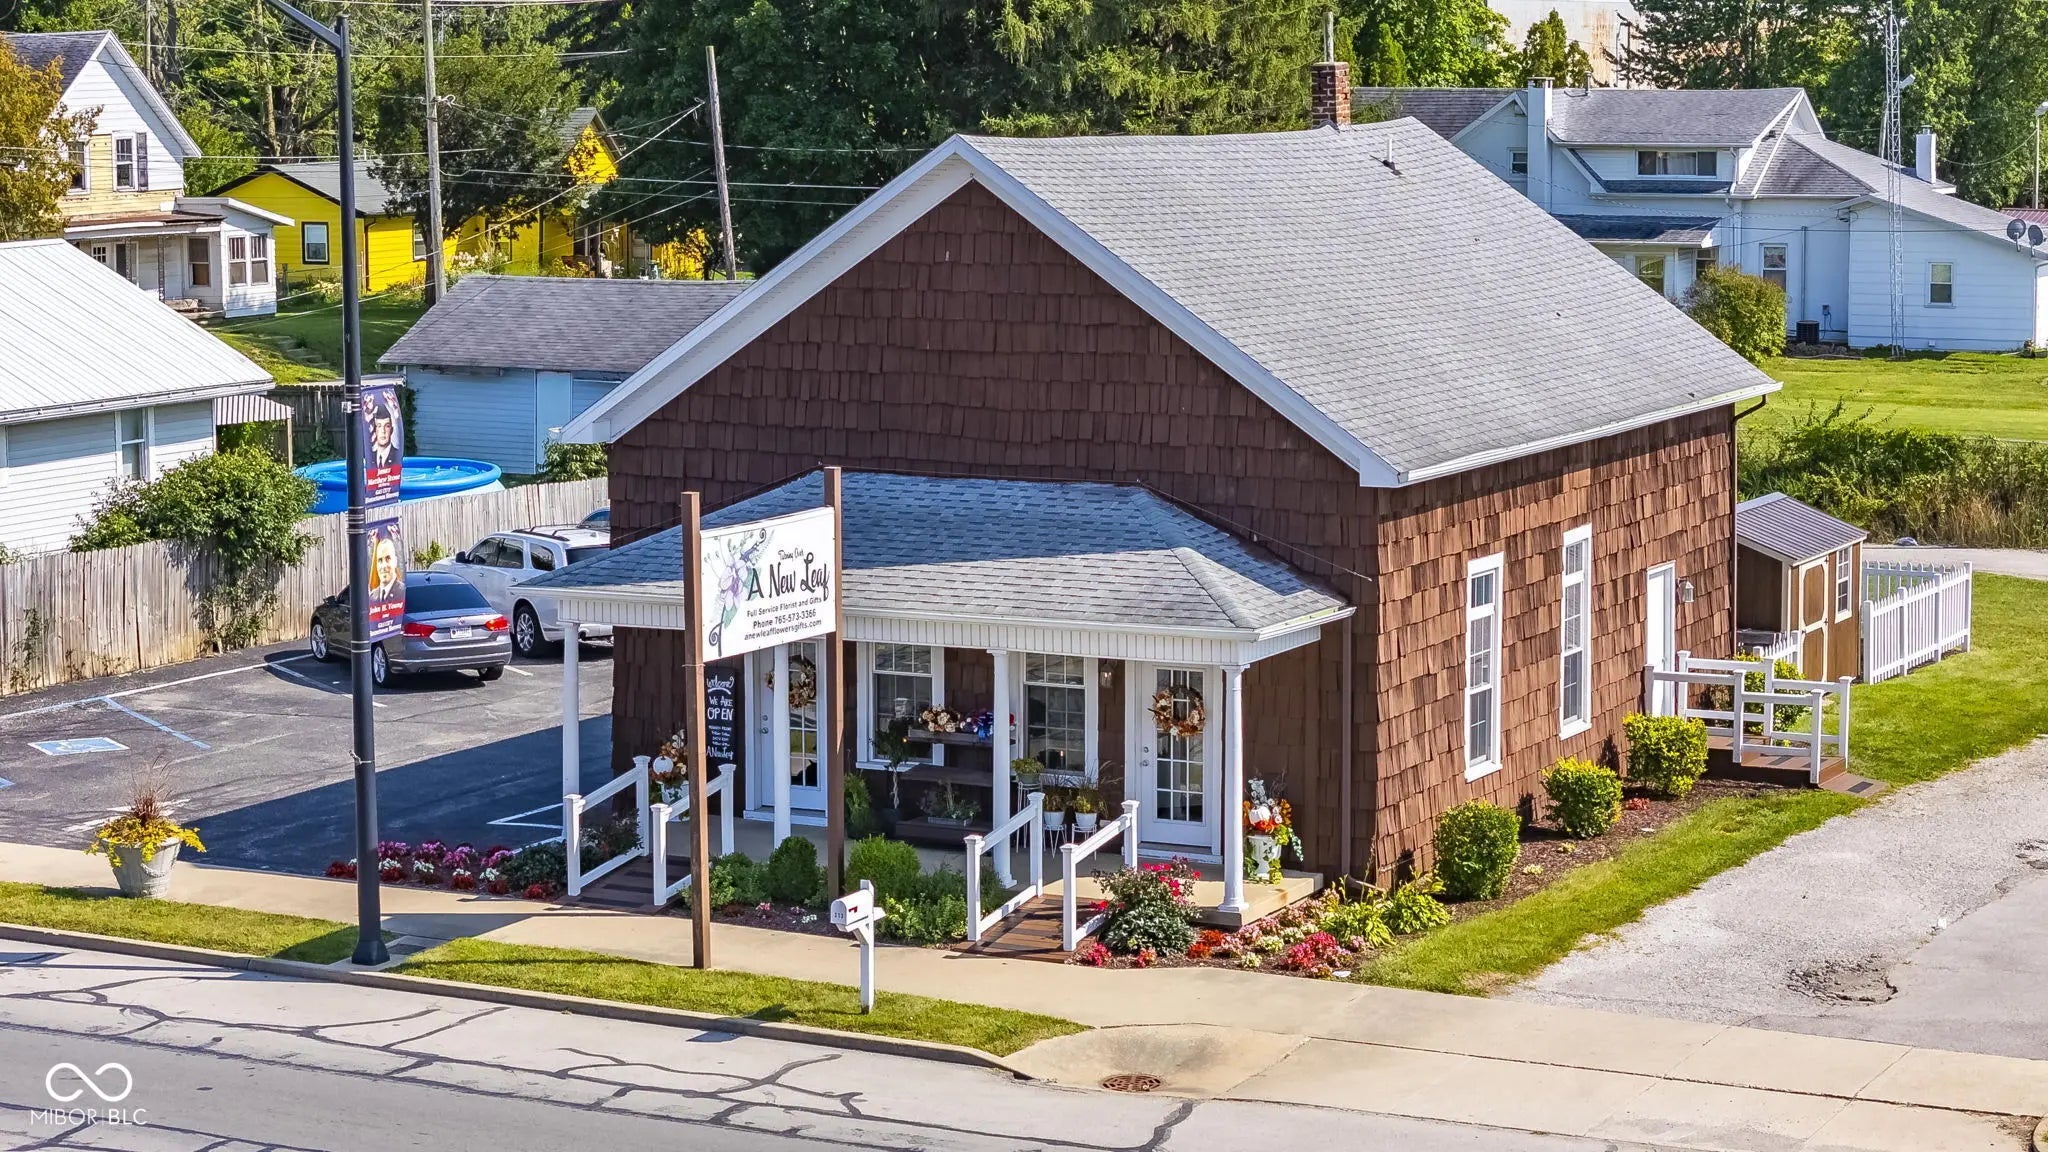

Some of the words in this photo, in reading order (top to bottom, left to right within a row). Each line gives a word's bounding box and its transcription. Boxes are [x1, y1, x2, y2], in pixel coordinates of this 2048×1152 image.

[747, 568, 764, 600] A
[769, 562, 796, 598] New
[800, 552, 830, 601] Leaf
[747, 609, 757, 618] Full
[758, 605, 779, 615] Service
[780, 600, 797, 611] Florist
[798, 599, 809, 607] and
[810, 597, 822, 605] Gifts
[745, 619, 822, 640] anewleafflowersgifts.com
[753, 619, 773, 629] Phone
[775, 609, 817, 624] 765-573-3366
[707, 708, 734, 720] OPEN
